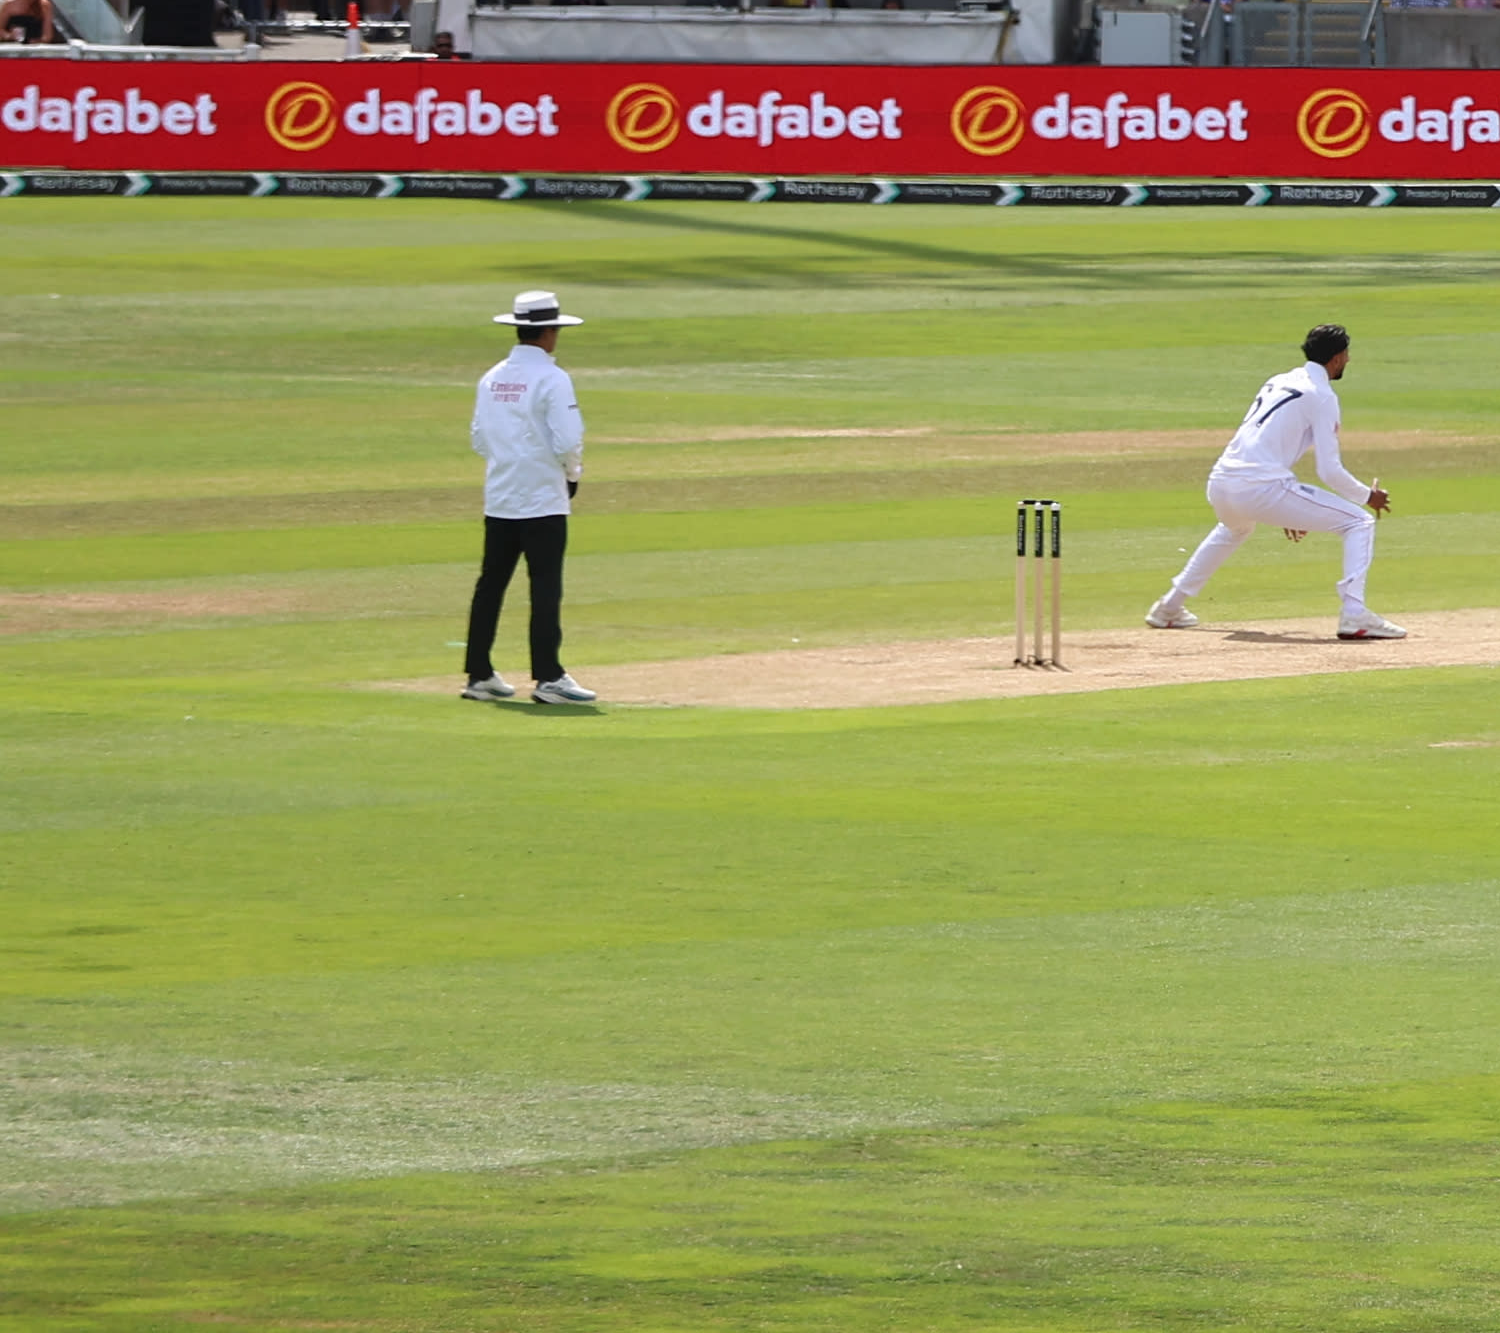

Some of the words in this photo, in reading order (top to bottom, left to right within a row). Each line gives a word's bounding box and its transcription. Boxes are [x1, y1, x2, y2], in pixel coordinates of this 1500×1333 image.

[2, 86, 216, 141] dafabet
[345, 89, 558, 143] dafabet
[688, 91, 901, 146] dafabet
[1033, 93, 1247, 148] dafabet
